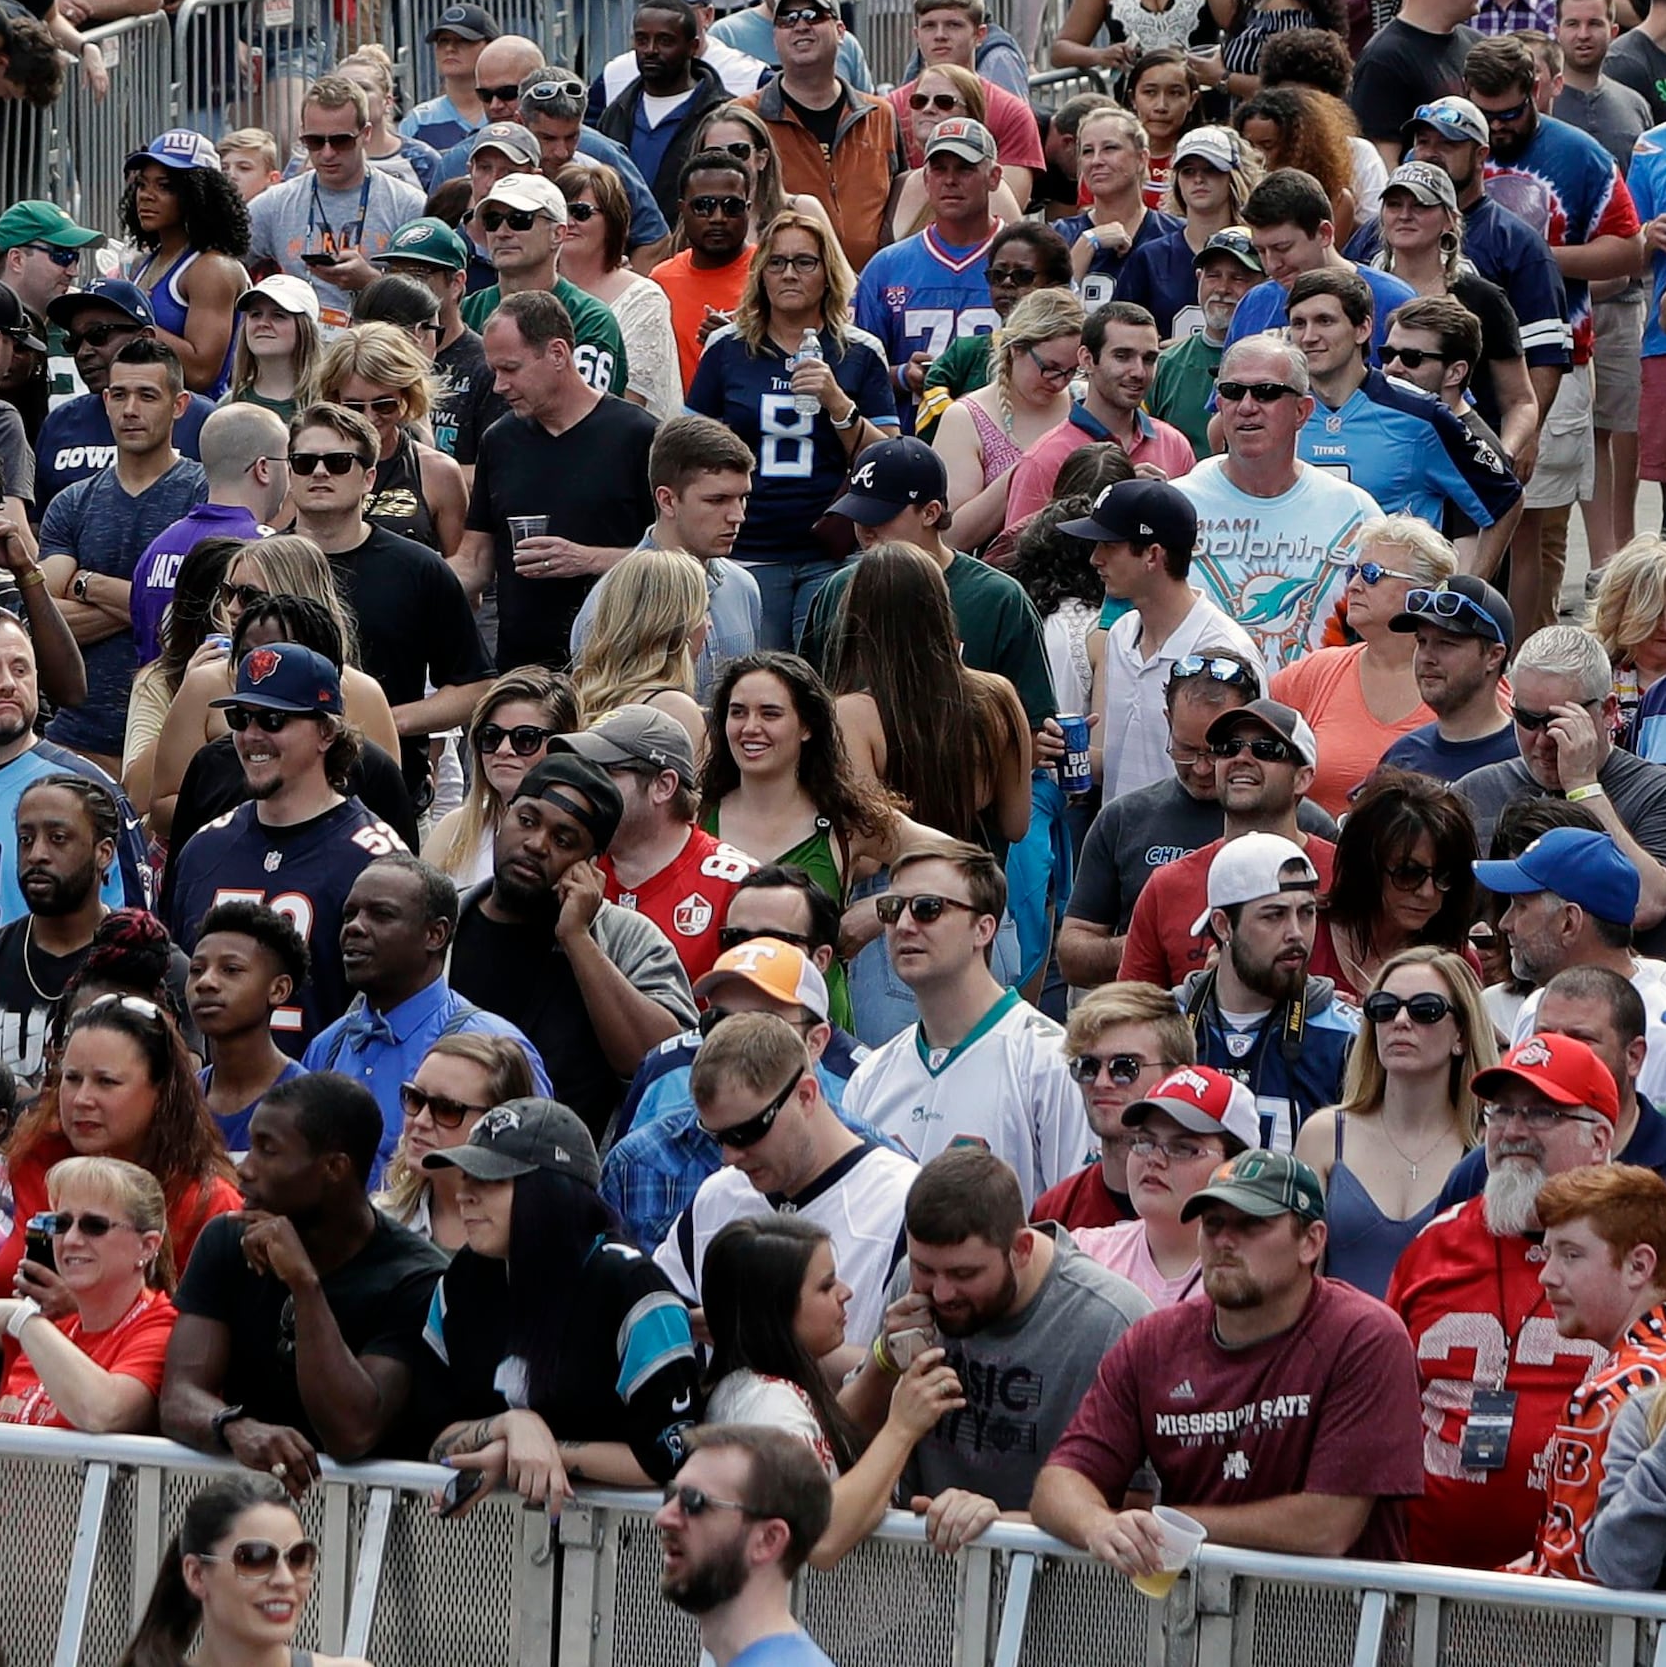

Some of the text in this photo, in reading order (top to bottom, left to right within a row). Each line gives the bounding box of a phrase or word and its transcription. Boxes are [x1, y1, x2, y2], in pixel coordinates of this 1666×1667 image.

[574, 344, 614, 394] 66
[759, 393, 815, 478] 8
[1312, 443, 1347, 457] TITANS
[733, 944, 776, 972] T
[1289, 1000, 1302, 1032] Nikon
[1259, 1394, 1311, 1421] SATE
